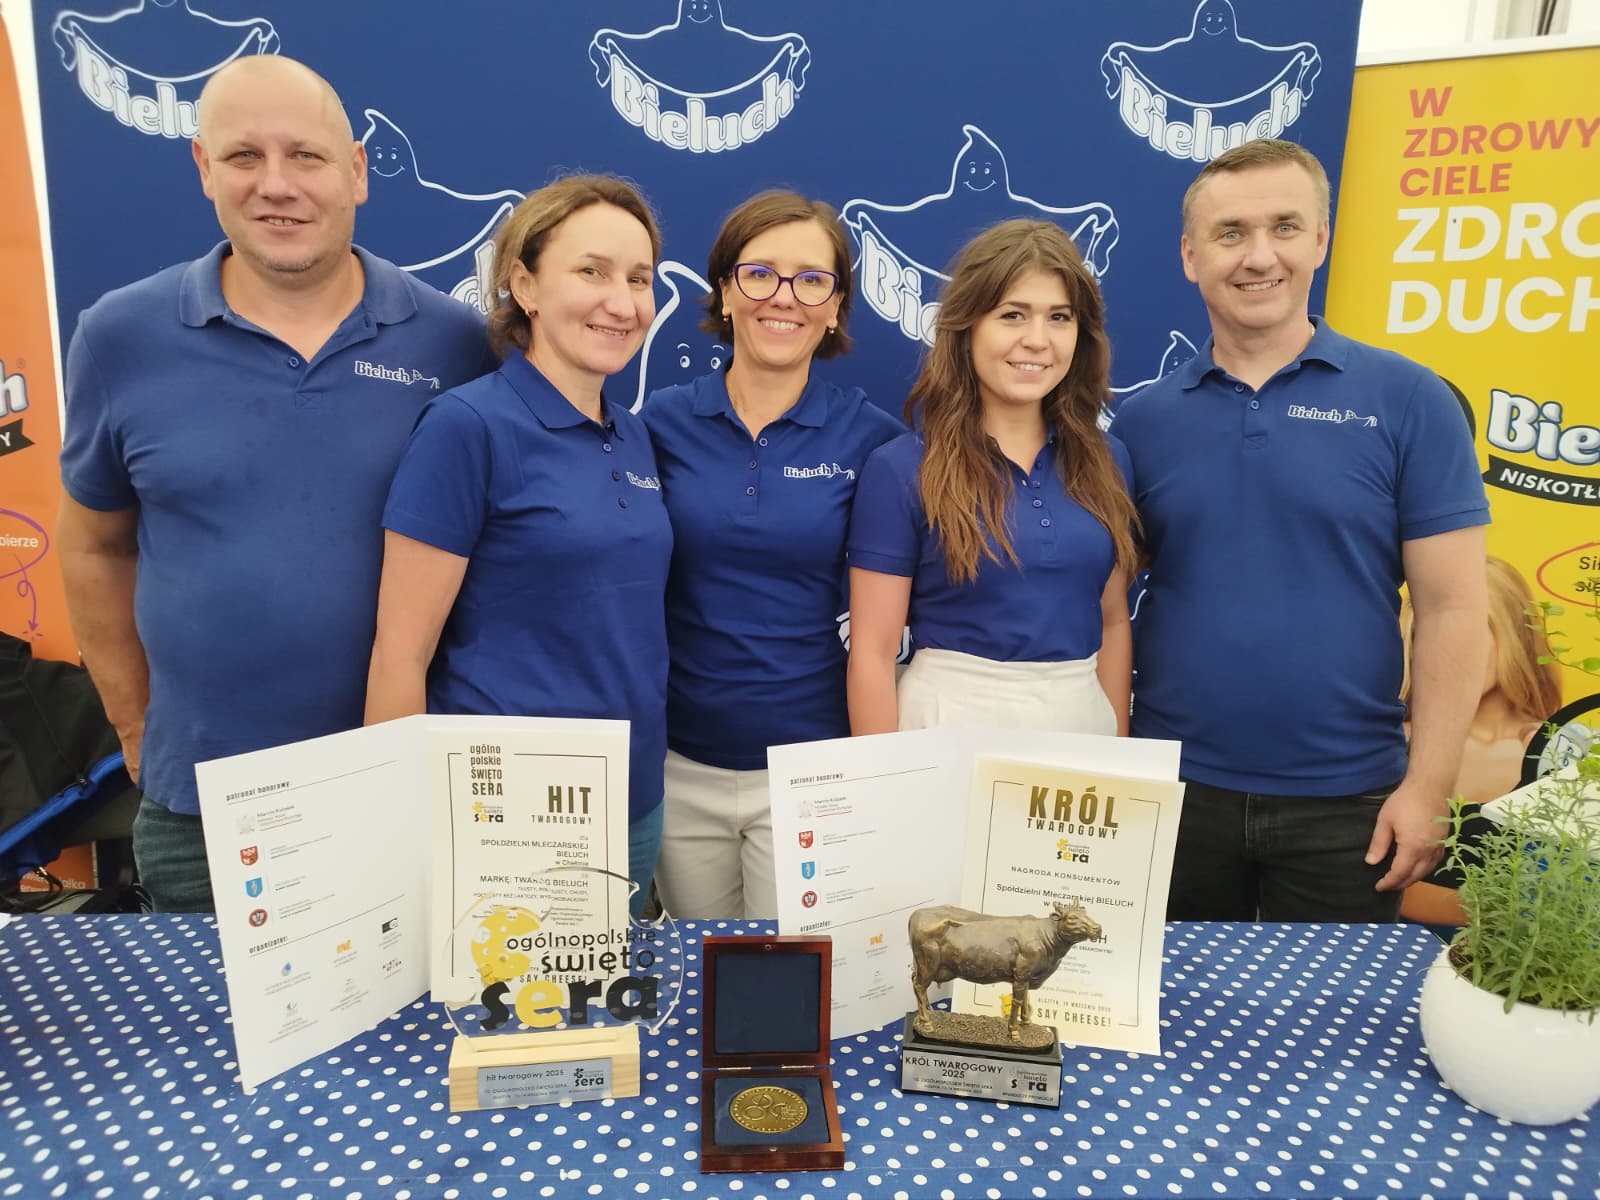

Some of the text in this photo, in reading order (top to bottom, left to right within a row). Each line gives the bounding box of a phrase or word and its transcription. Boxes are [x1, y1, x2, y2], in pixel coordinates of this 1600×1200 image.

[76, 36, 201, 139] Bielu
[610, 53, 795, 153] Bieluch
[1409, 86, 1453, 118] W
[1403, 117, 1600, 158] ZDROWY
[1399, 162, 1513, 197] CIELE
[354, 360, 411, 385] Bieluch
[1288, 404, 1342, 422] Bieluch
[1486, 388, 1600, 466] Bie
[784, 463, 832, 479] Bieluch
[1499, 468, 1600, 499] NISKOTŁ
[470, 743, 501, 755] ogólno
[470, 756, 501, 767] polskie
[471, 767, 503, 781] ŚWIĘTO
[472, 782, 503, 796] SERA
[548, 785, 591, 814] HIT
[1029, 785, 1119, 828] KRÓL
[474, 813, 504, 823] sera
[531, 815, 592, 825] TWAROGOWY
[1027, 818, 1118, 840] TWAROGOWY
[531, 841, 589, 850] MLECZARSKIEJ
[556, 850, 589, 859] BIELUCH
[1056, 850, 1089, 863] sera
[552, 879, 589, 888] BIELUCH
[1011, 866, 1121, 886] NAGRODA KONSUMENTÓW
[1042, 890, 1094, 905] Mleczarskiej
[1096, 896, 1134, 908] BIELUCH
[506, 928, 657, 952] ogólnopolskie
[541, 946, 656, 974] święto
[480, 976, 658, 1031] sera
[1037, 1008, 1112, 1027] SAY CHEESE!
[905, 1055, 1004, 1074] KRÓL TWAROGOWY
[498, 1071, 543, 1081] twarogowy
[574, 1077, 604, 1087] sera
[941, 1069, 965, 1079] 2025
[1011, 1078, 1047, 1092] sra
